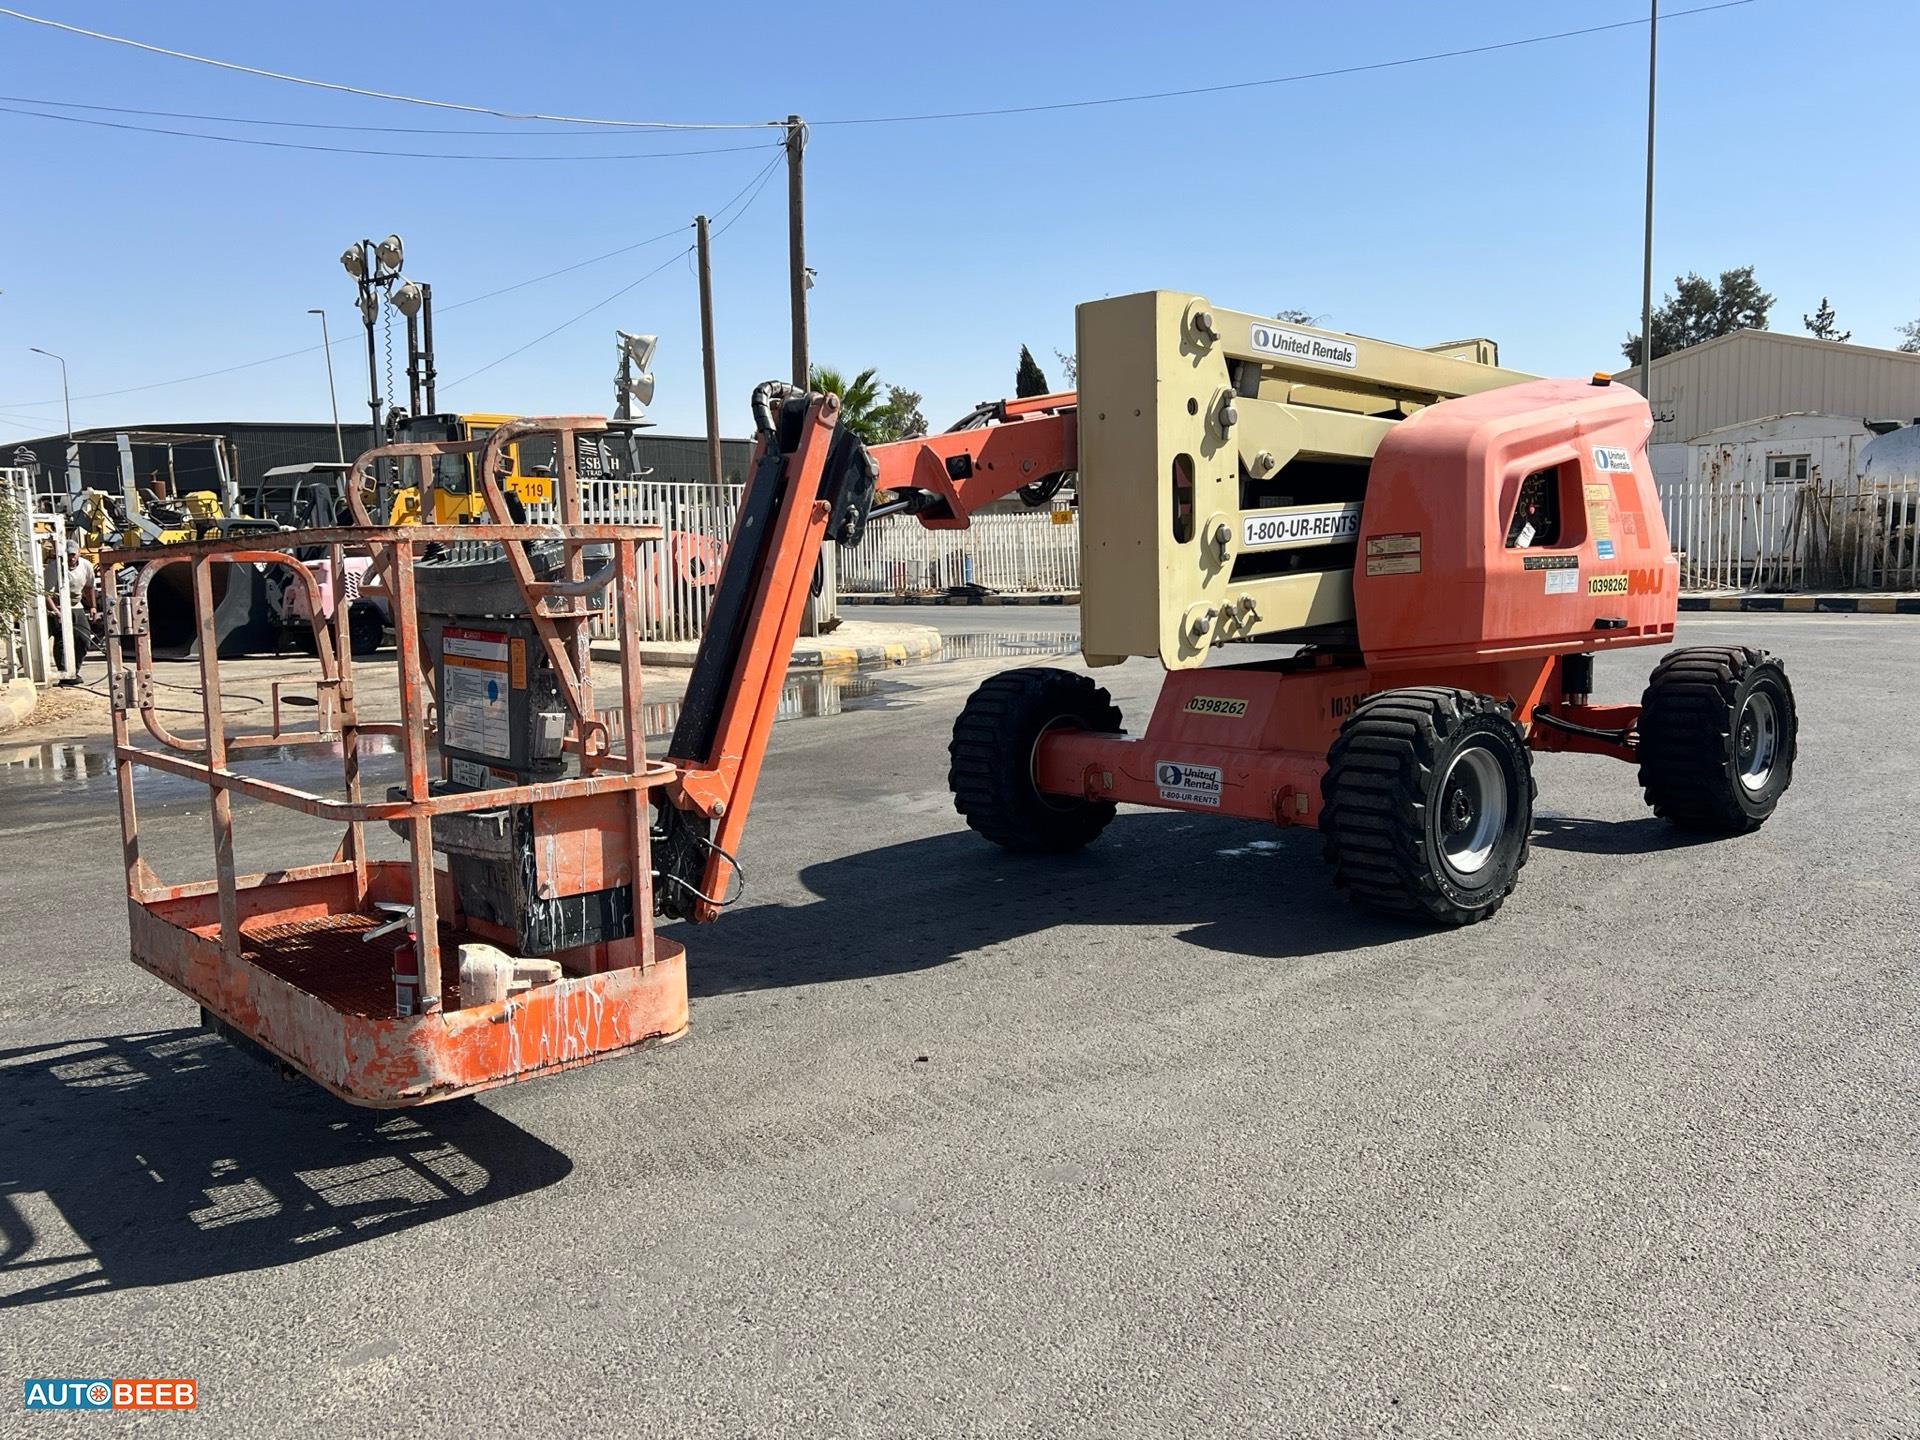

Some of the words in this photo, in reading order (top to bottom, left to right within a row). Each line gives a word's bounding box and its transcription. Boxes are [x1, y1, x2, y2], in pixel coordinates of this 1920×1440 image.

[1271, 333, 1311, 354] United
[1312, 341, 1352, 363] Rentals
[1608, 450, 1626, 460] United
[1610, 460, 1630, 470] Rentals
[525, 483, 543, 497] 119
[1247, 515, 1358, 541] 1-800-UR-RENTS
[1588, 577, 1628, 593] 10398262
[1184, 768, 1217, 780] United
[1184, 778, 1220, 791] Rentals
